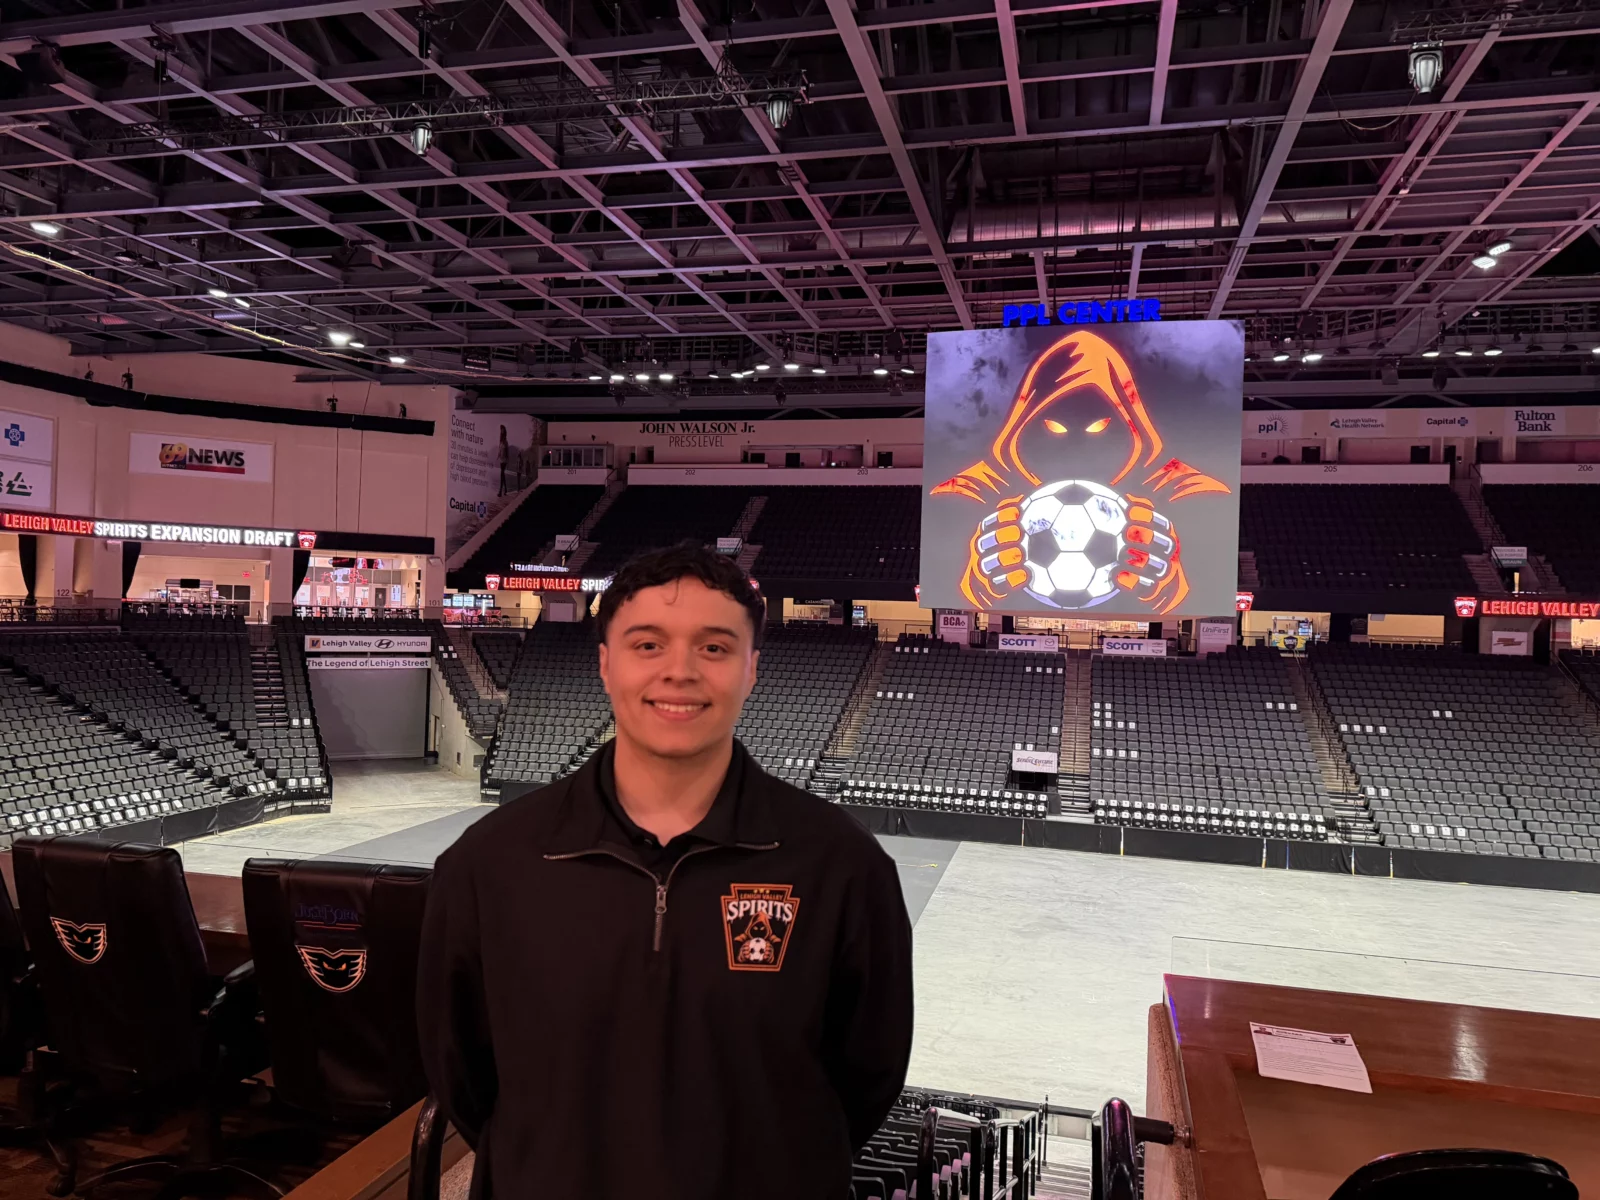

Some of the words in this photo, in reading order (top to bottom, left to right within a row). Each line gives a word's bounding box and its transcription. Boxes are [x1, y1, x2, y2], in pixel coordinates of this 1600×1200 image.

[1003, 304, 1050, 327] PPL
[1057, 299, 1161, 324] CENTER
[1426, 417, 1456, 426] Capital
[1514, 410, 1556, 421] Fulton
[451, 414, 476, 431] Connect
[640, 422, 676, 434] JOHN
[680, 422, 737, 434] WALSON
[741, 422, 756, 433] Jr.
[1258, 421, 1277, 433] ppl
[1341, 418, 1361, 426] Lehigh
[1517, 421, 1552, 432] Bank
[450, 428, 465, 440] with
[465, 432, 484, 445] nature
[669, 435, 697, 447] PRESS
[698, 435, 724, 447] LEVEL
[159, 442, 187, 464] 69
[188, 447, 245, 467] NEWS
[1323, 465, 1338, 473] 205
[449, 497, 476, 513] Capital
[4, 513, 49, 530] LEHIGH
[51, 518, 94, 534] VALLEY
[94, 521, 148, 539] SPIRITS
[151, 524, 241, 545] EXPANSION
[244, 529, 294, 547] DRAFT
[503, 577, 540, 589] LEHIGH
[542, 578, 581, 590] VALLEY
[56, 589, 70, 597] 122
[1482, 600, 1539, 615] LEHIGH
[1541, 602, 1600, 617] VALLEY
[943, 616, 961, 626] BCA
[349, 640, 372, 648] Valley
[1001, 637, 1037, 647] SCOTT
[1106, 641, 1144, 651] SCOTT
[324, 660, 357, 668] Legend
[370, 660, 400, 668] Lehigh
[727, 900, 793, 923] SPIRITS
